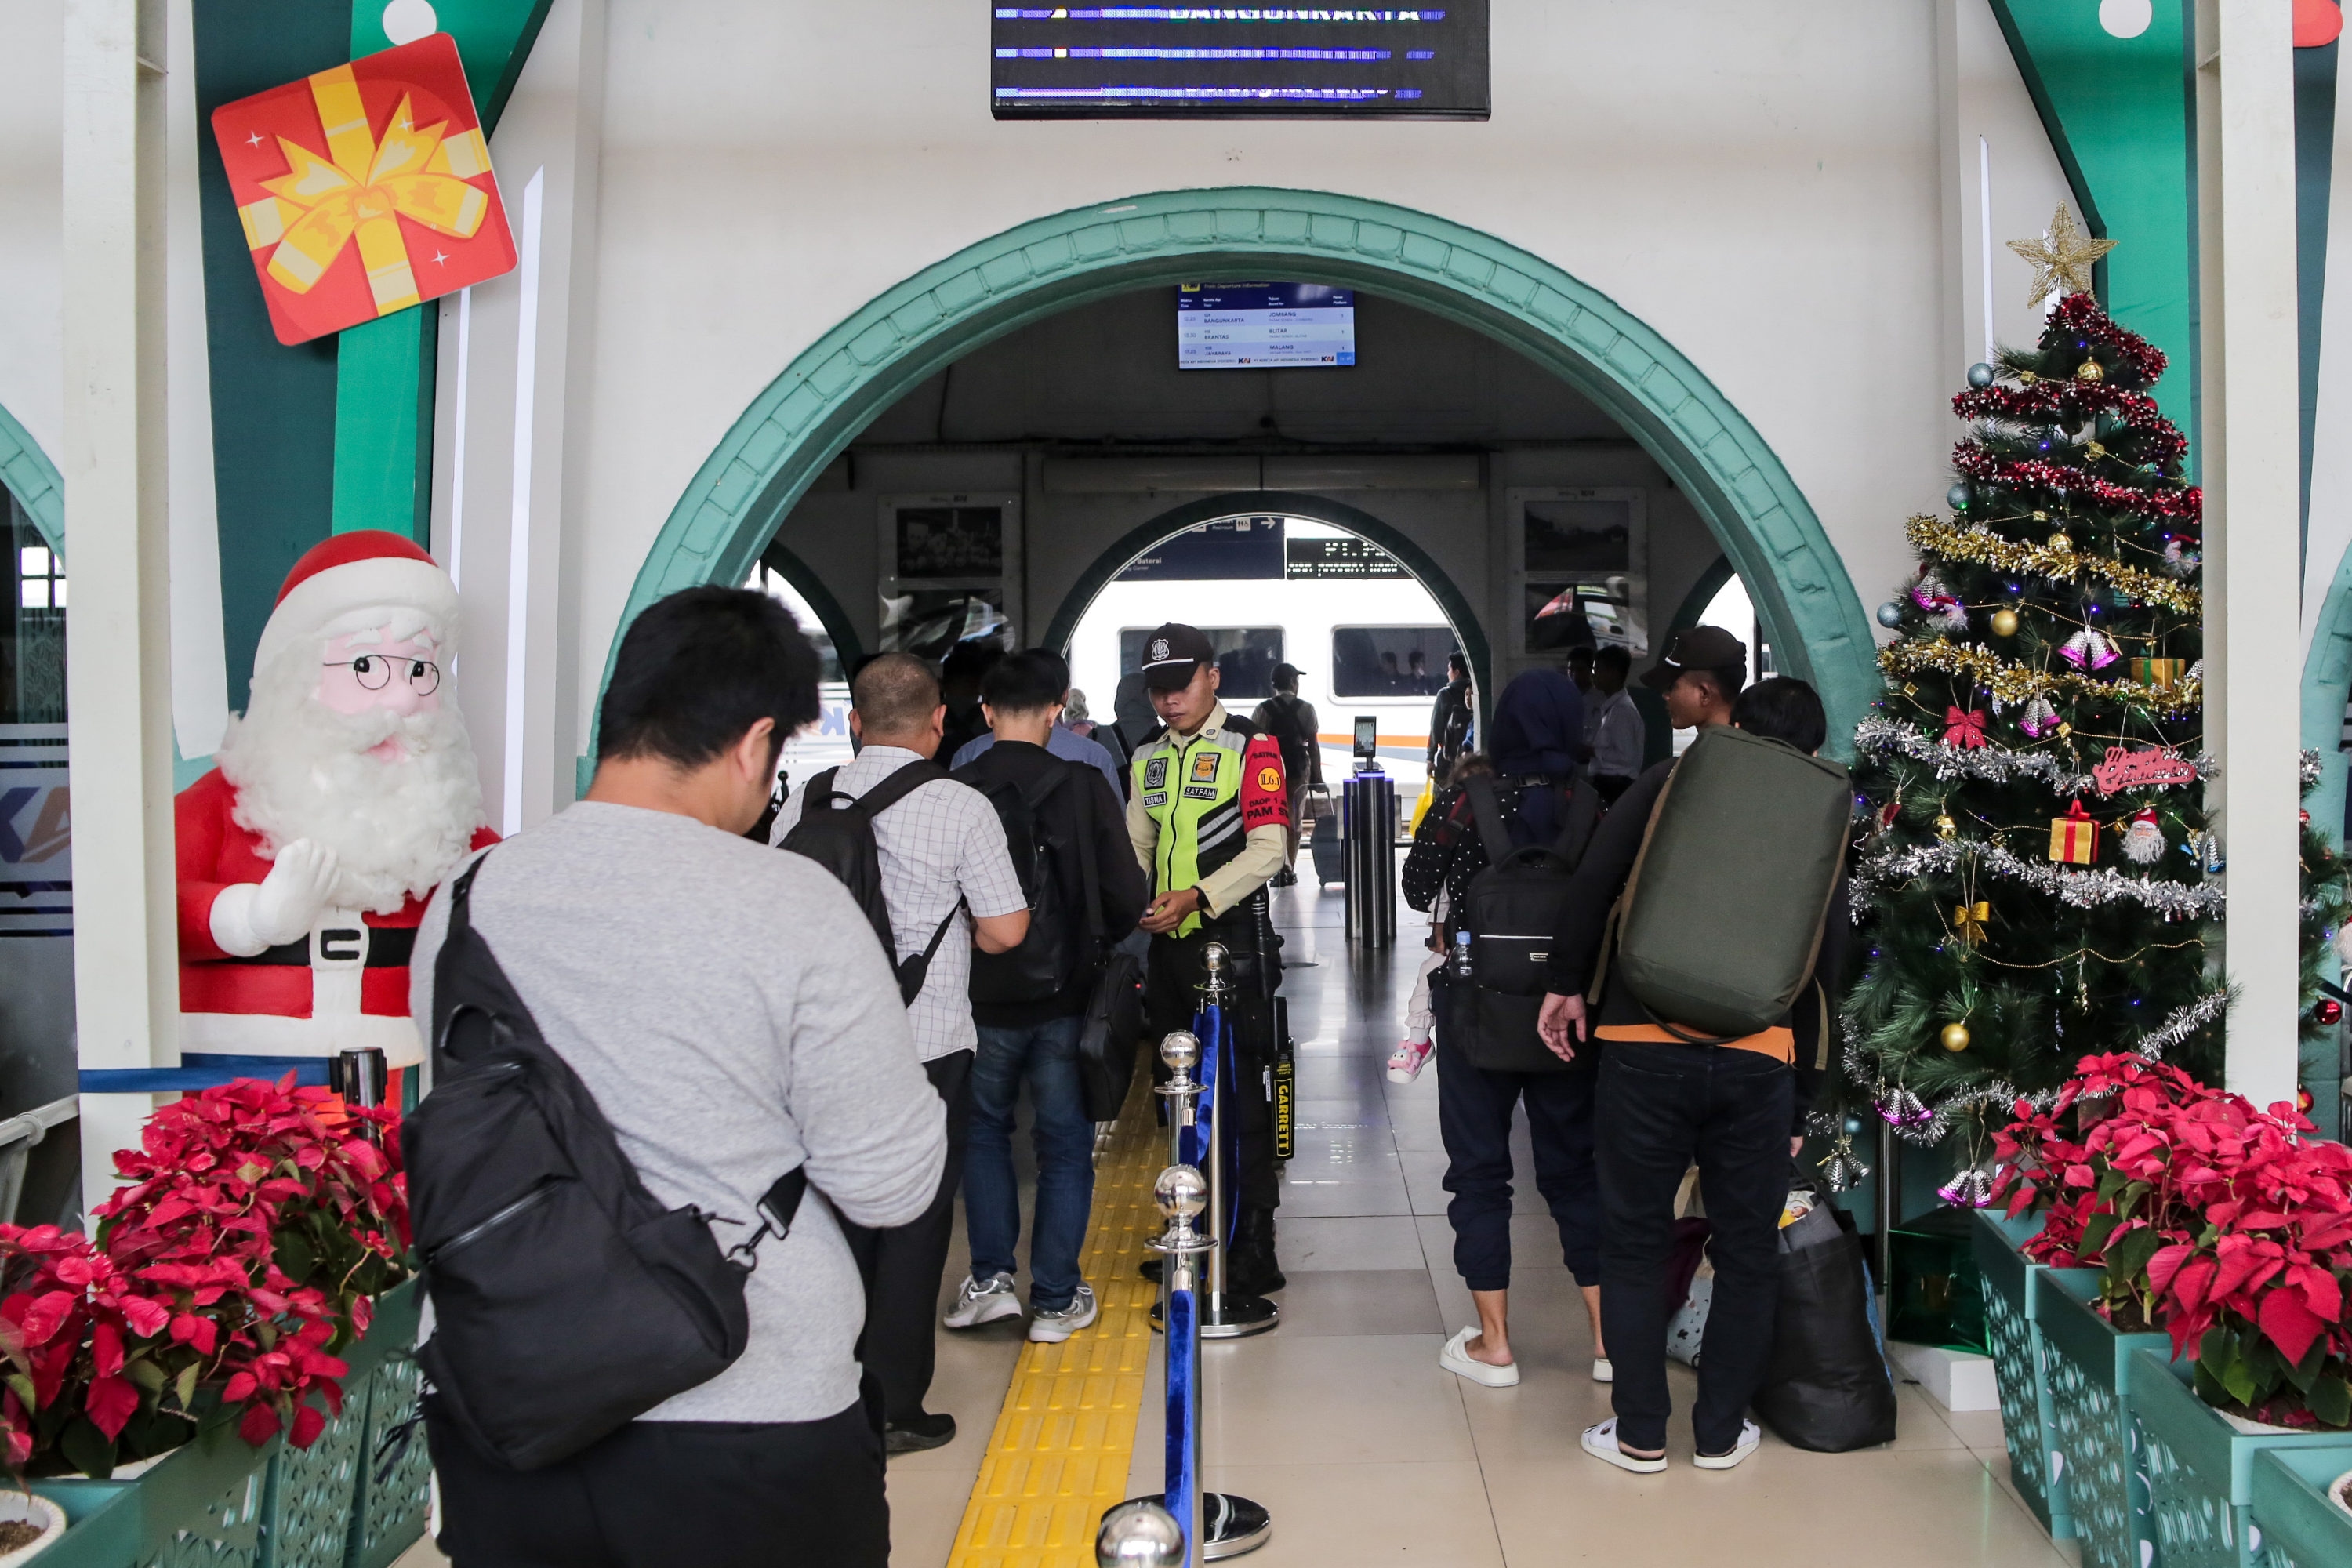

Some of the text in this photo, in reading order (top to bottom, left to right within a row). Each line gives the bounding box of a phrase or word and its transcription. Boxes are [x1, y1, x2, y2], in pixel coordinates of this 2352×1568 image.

[1185, 787, 1215, 797] SATPAM
[1145, 795, 1163, 805] TISNA
[1249, 798, 1271, 808] DAOP
[1247, 806, 1273, 820] PAM
[0, 787, 71, 863] KA
[1279, 1084, 1289, 1150] GARRETT
